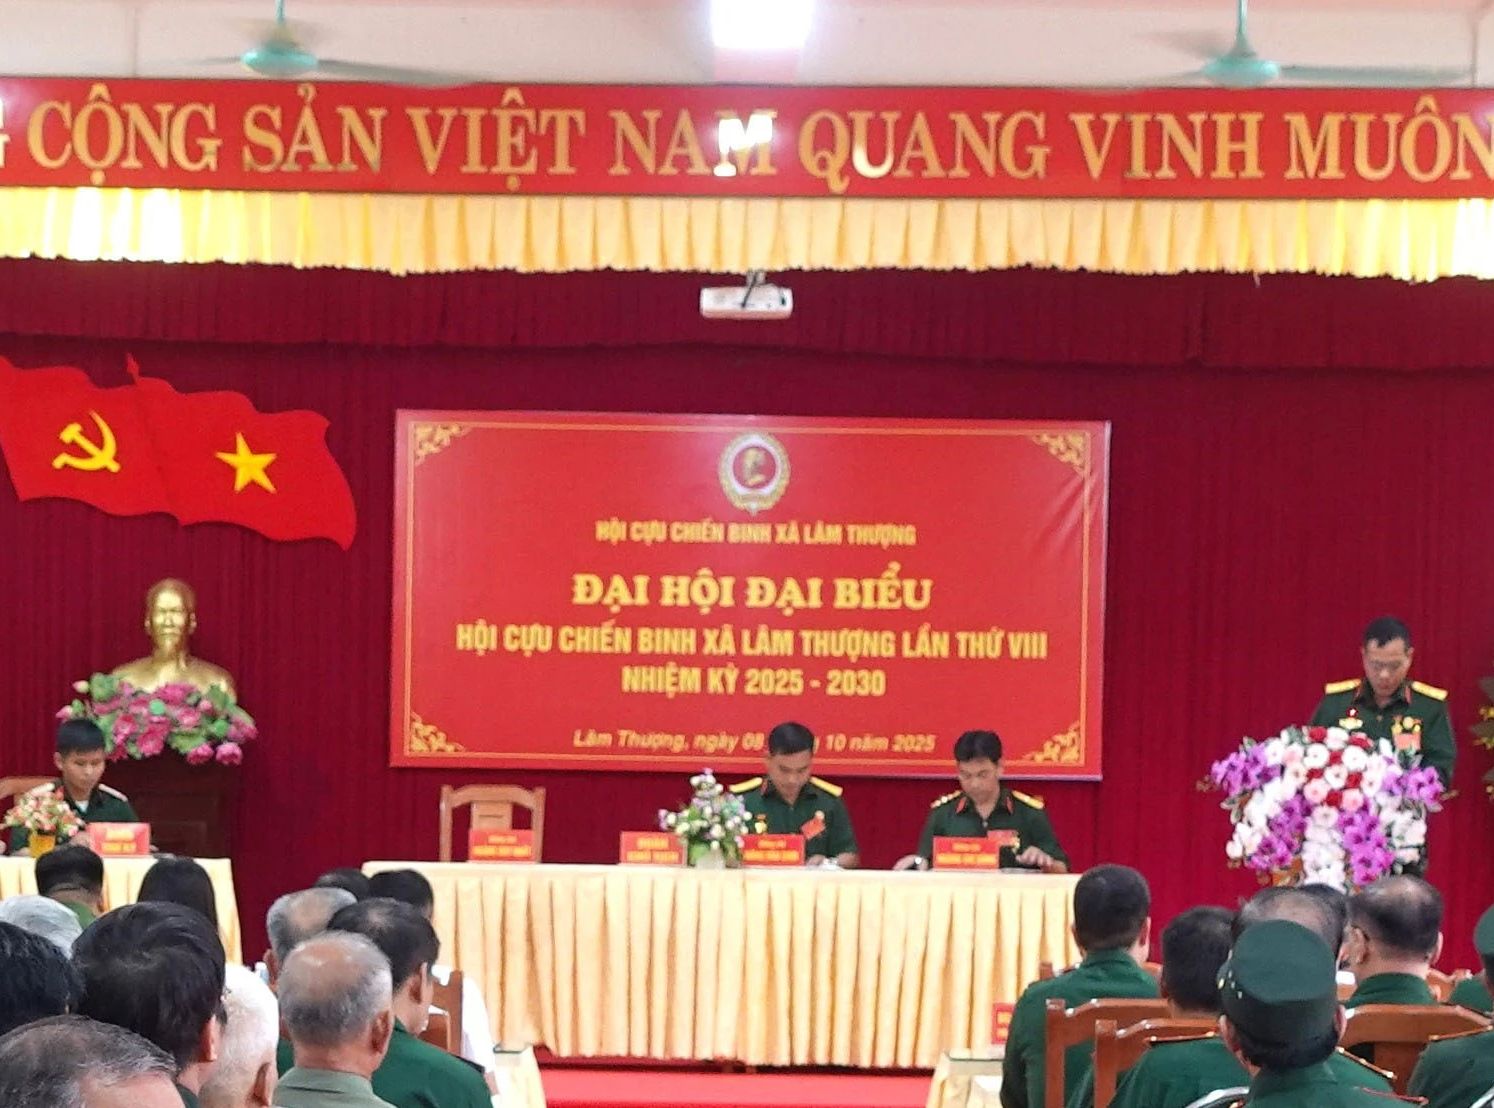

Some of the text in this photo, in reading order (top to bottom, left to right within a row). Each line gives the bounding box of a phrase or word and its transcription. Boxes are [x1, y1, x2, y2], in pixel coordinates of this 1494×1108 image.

[28, 82, 222, 186] CỘNG
[242, 83, 388, 173] SẢN
[407, 88, 585, 191] VIỆT
[608, 107, 778, 176] NAM
[797, 110, 1051, 194] QUANG
[1068, 111, 1264, 180] VINH
[595, 517, 627, 545] HỘI
[630, 520, 667, 546] CỰU
[670, 517, 724, 544] CHIẾN
[726, 522, 772, 544] BINH
[775, 520, 800, 545] XÃ
[803, 520, 842, 546] LÂM
[572, 561, 933, 617] ĐẠI HỘI ĐẠI BIỂU
[457, 618, 1048, 663] HỘI CỰU CHIẾN BINH XÃ LÂM THƯỢNG LẦN THỨ VIII
[621, 661, 886, 699] NHIỆM KỲ 2025 - 2030
[825, 732, 847, 751] 10
[891, 734, 937, 753] 2025
